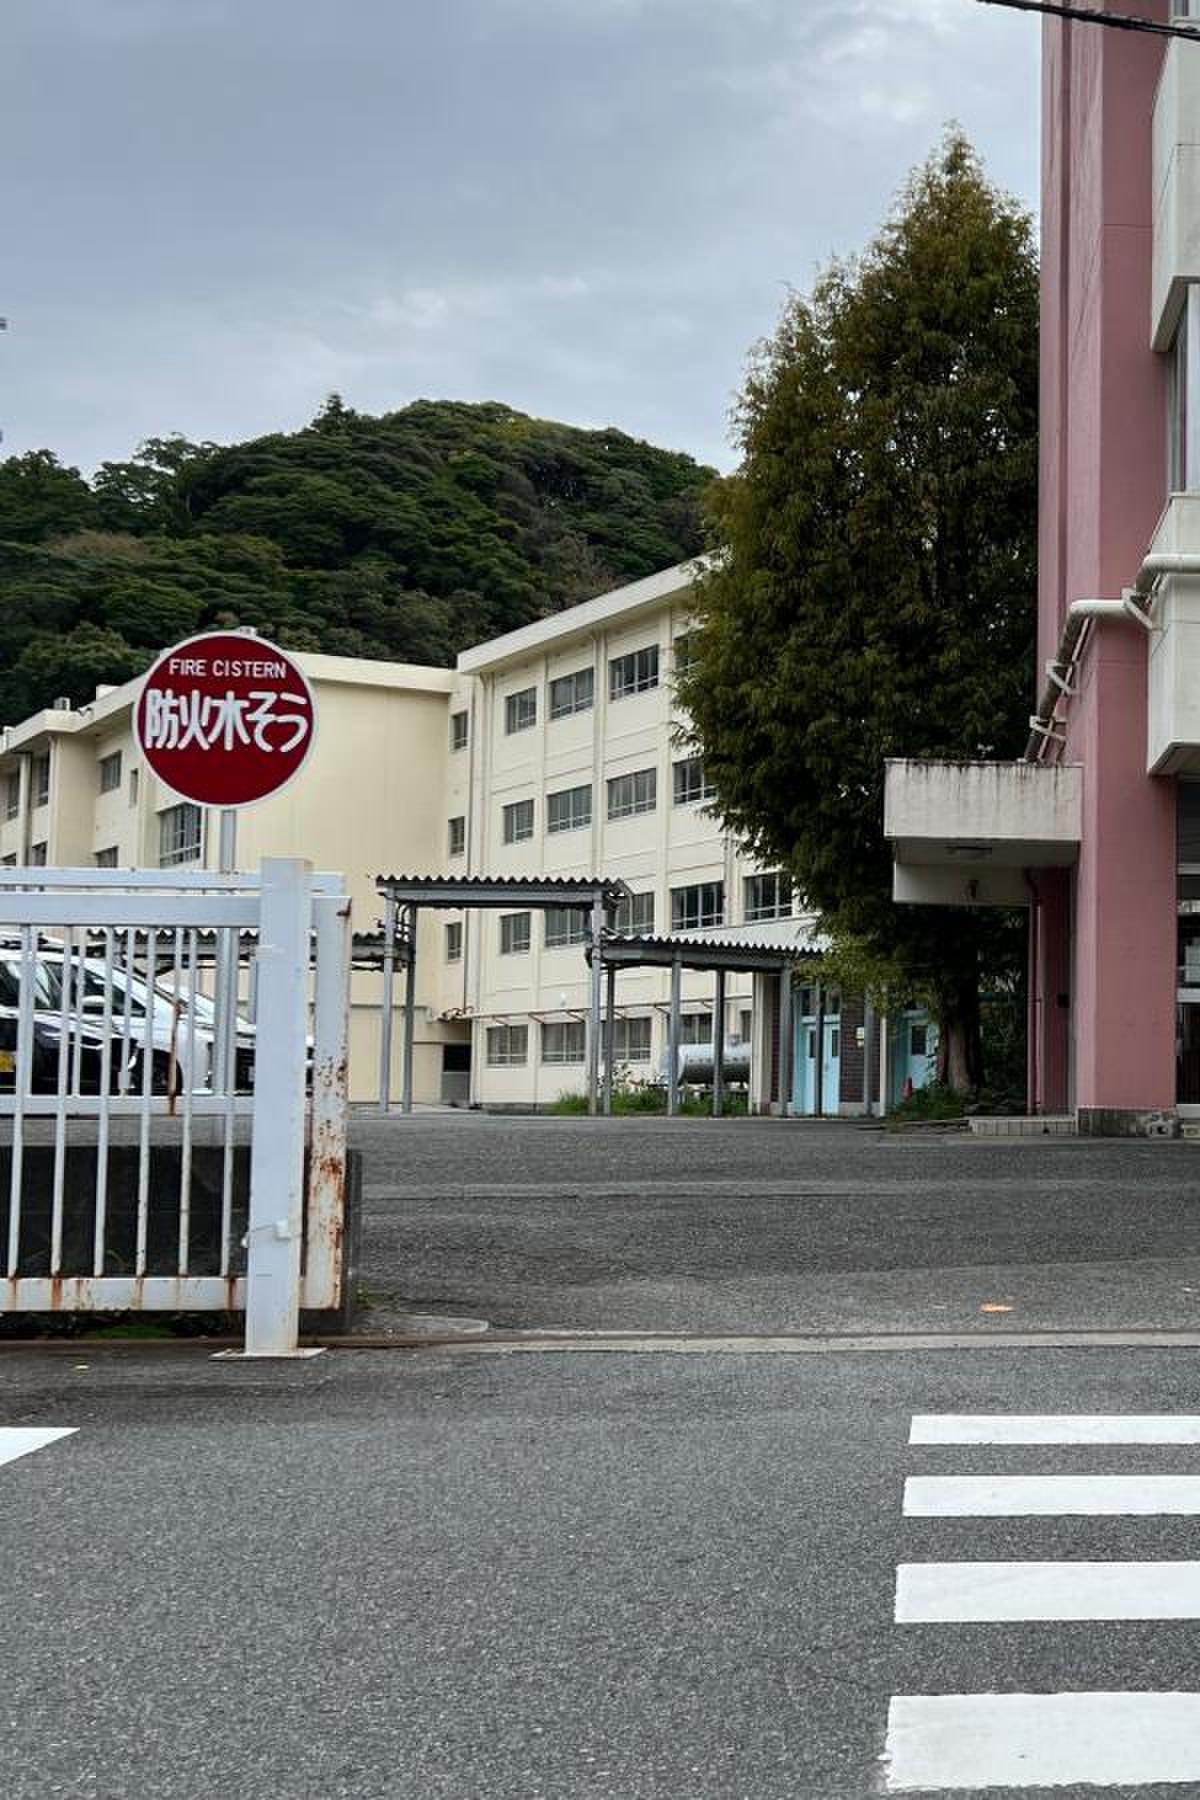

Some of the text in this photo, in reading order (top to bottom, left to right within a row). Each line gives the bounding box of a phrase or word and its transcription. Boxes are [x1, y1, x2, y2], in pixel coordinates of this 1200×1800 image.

[169, 659, 286, 679] FIRE CISTERN
[145, 689, 308, 752] 防火水そう
